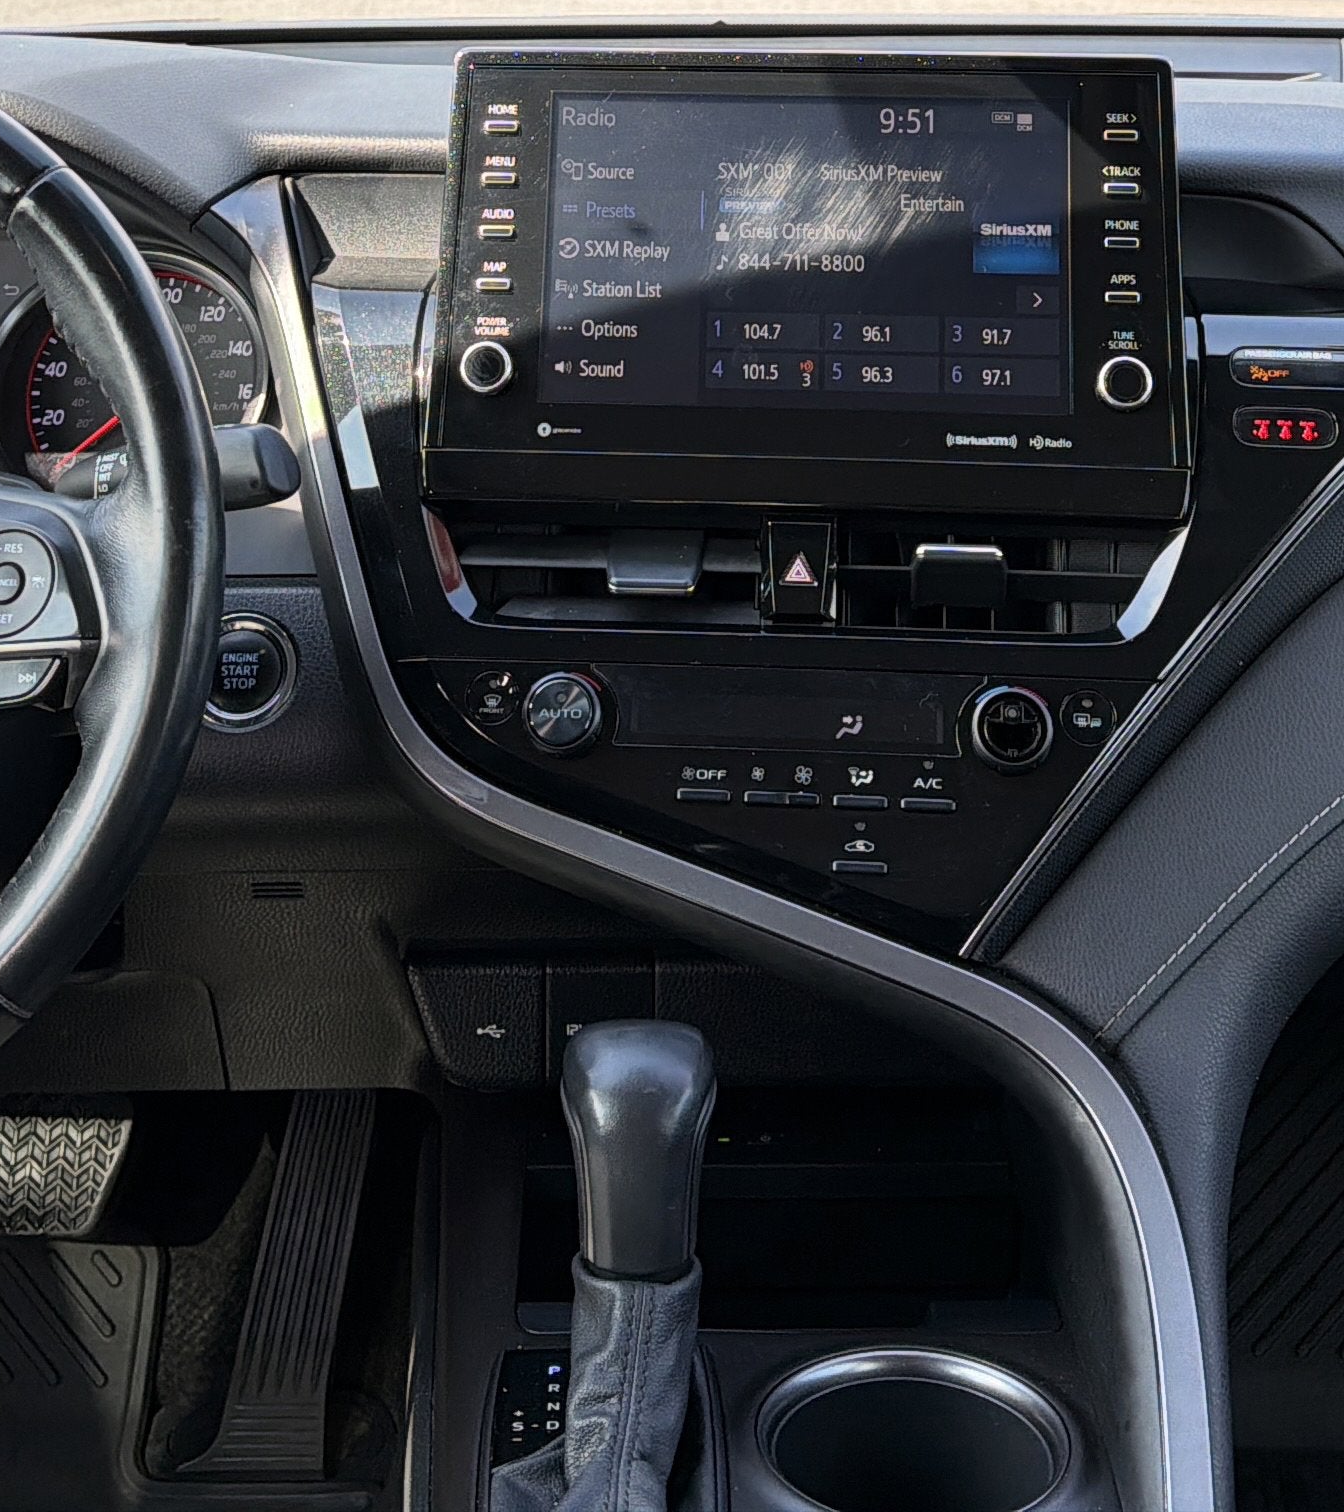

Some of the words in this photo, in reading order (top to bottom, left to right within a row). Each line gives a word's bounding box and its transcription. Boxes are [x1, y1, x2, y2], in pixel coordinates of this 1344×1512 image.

[488, 104, 518, 116] HOME
[562, 107, 616, 127] Radio
[879, 108, 935, 134] 9:51
[485, 156, 516, 167] MENU
[587, 162, 635, 180] Source
[763, 163, 793, 180] 001
[820, 164, 884, 182] SiriusXM
[887, 165, 943, 183] Preview
[586, 201, 636, 218] Presets
[900, 195, 965, 212] Entertain
[482, 209, 515, 219] AUDIO
[739, 222, 779, 239] Great
[782, 223, 823, 240] Offer
[980, 223, 1052, 236] SiriusXM
[1104, 220, 1139, 230] PHONE
[584, 241, 619, 257] SXM
[623, 242, 671, 261] Replay
[483, 262, 507, 272] MAP
[738, 254, 865, 272] 844-711-8800
[1110, 275, 1137, 285] APPS
[582, 280, 633, 297] Station
[636, 281, 663, 298] List
[162, 288, 183, 303] 00
[199, 306, 226, 322] 120
[477, 317, 507, 326] POWER
[474, 326, 510, 336] VOLUME
[581, 319, 638, 340] Options
[714, 320, 721, 337] 1
[743, 324, 782, 340] 104.7
[832, 322, 843, 340] 2
[862, 326, 891, 342] 96.1
[952, 325, 962, 342] 3
[982, 329, 1012, 345] 91.7
[1113, 331, 1135, 340] TUNE
[198, 335, 216, 344] 200
[1108, 340, 1139, 350] SCROLL
[210, 349, 228, 359] 220
[227, 340, 253, 357] 140
[44, 361, 68, 377] 40
[218, 369, 237, 379] 240
[579, 360, 624, 378] Sound
[712, 360, 724, 378] 4
[742, 364, 779, 380] 101.5
[832, 363, 842, 380] 5
[862, 366, 893, 383] 96.3
[1268, 369, 1290, 378] OFF
[73, 377, 87, 386] 60
[802, 373, 811, 387] 3
[951, 366, 962, 383] 6
[982, 369, 1011, 386] 97.1
[238, 384, 254, 399] 16
[71, 398, 85, 407] 40
[42, 409, 65, 426] 20
[1044, 438, 1072, 448] Radio
[4, 543, 24, 554] RES
[222, 653, 259, 663] ENGINE
[221, 665, 260, 677] START
[223, 678, 257, 690] STOP
[538, 708, 582, 719] AUTO
[696, 769, 727, 781] OFF
[913, 778, 943, 790] A/C
[566, 1023, 583, 1036] 12
[548, 1365, 561, 1375] P
[548, 1383, 561, 1393] R
[547, 1402, 560, 1411] N
[512, 1422, 524, 1431] S
[546, 1420, 560, 1430] D
